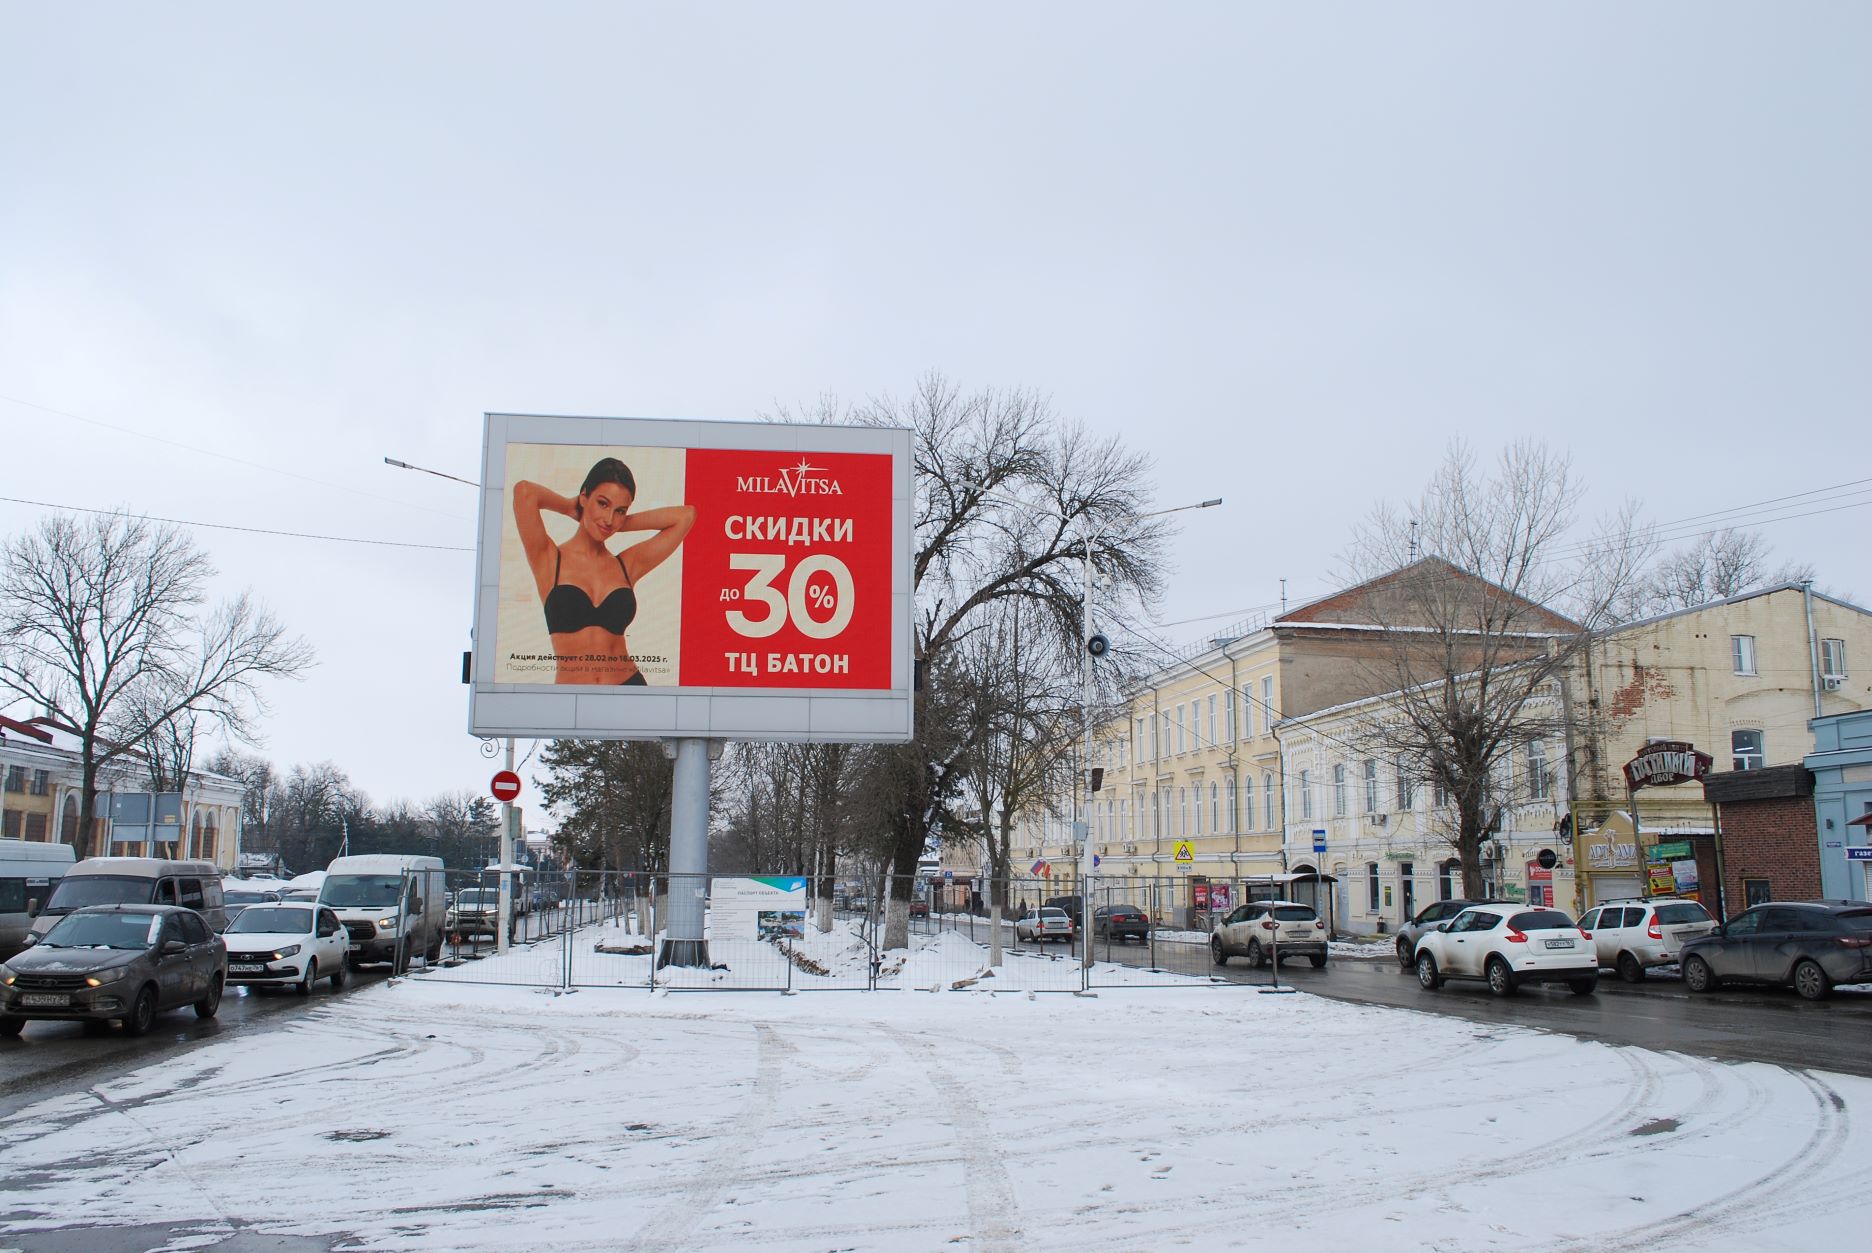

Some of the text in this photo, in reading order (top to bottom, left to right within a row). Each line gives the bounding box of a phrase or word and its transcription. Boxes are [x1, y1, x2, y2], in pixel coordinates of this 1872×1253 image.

[736, 467, 843, 498] MILAVITSA
[725, 515, 853, 546] СКИДКИ
[510, 653, 536, 661] Акция
[537, 654, 577, 663] действует
[725, 652, 849, 676] ТЦ БАТОН
[1651, 773, 1675, 784] ДВОР
